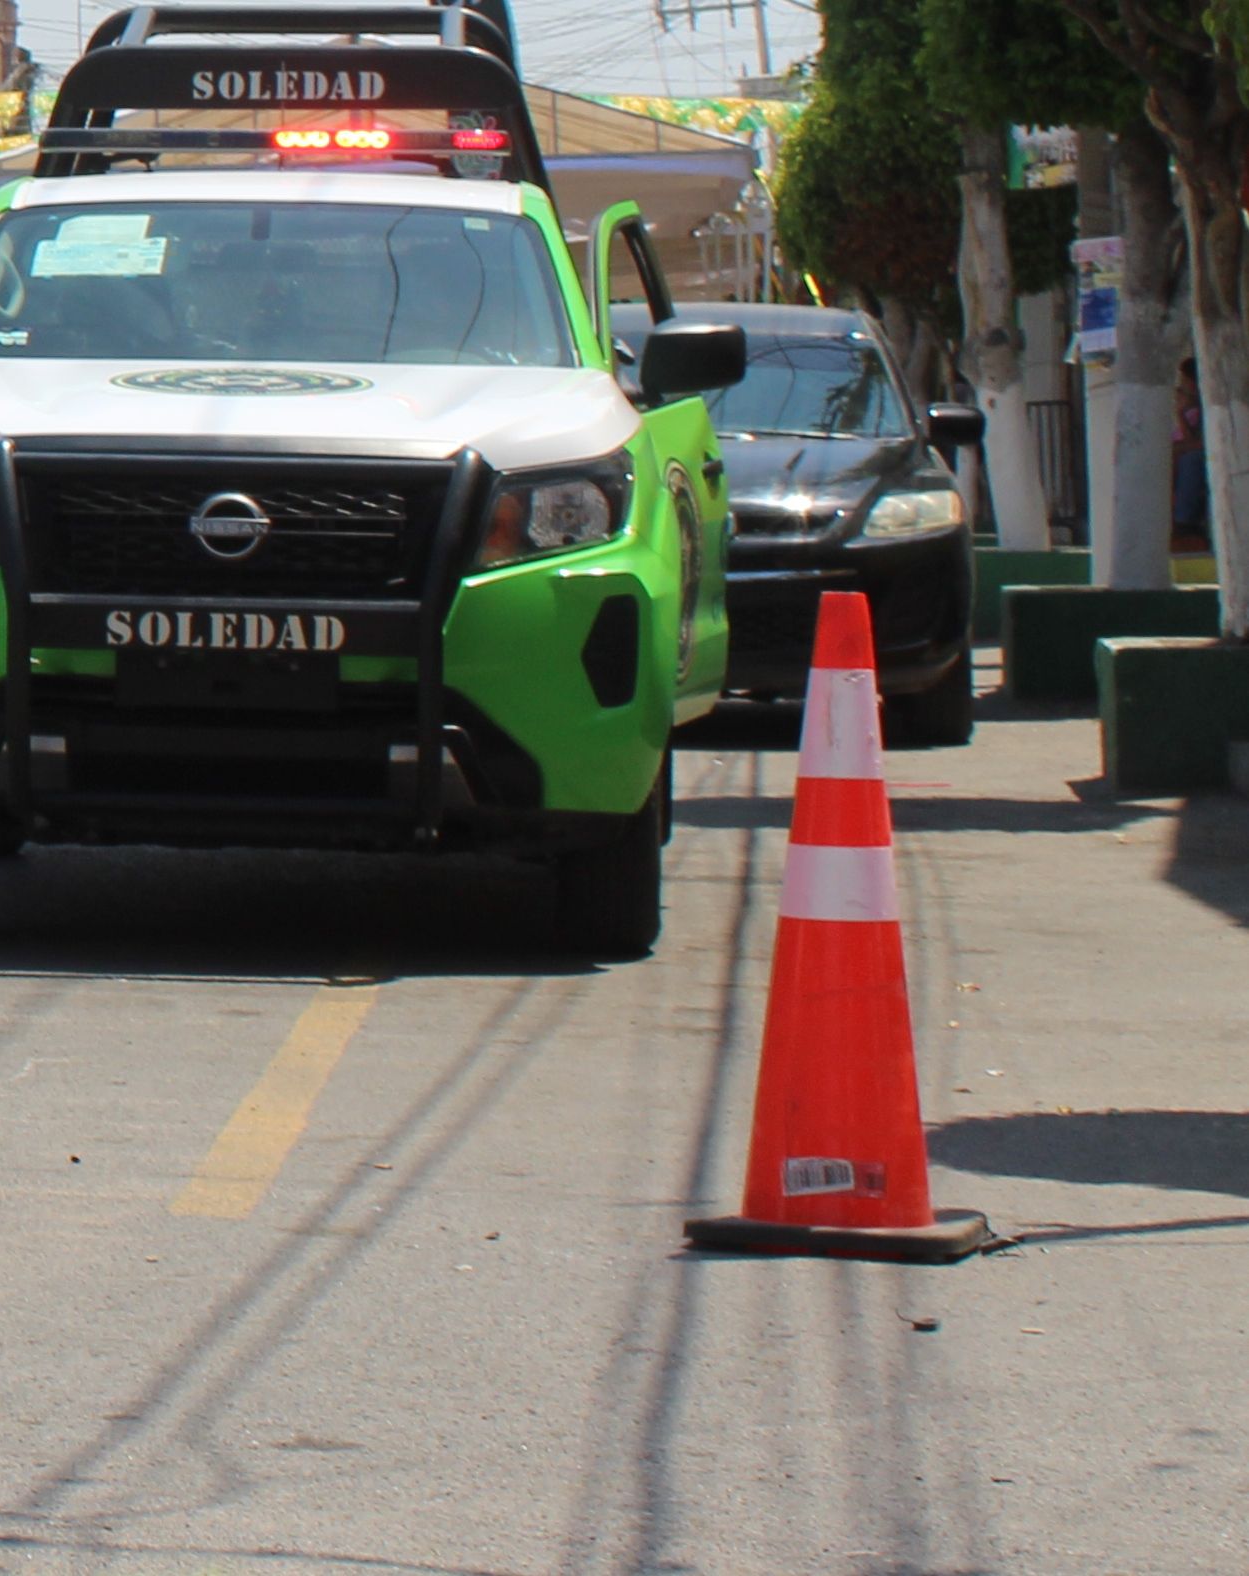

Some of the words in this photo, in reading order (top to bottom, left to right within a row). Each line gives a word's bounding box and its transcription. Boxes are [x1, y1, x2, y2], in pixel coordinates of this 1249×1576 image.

[191, 70, 386, 101] SOLEDAD
[192, 522, 268, 534] NISSAN
[106, 610, 346, 650] SOLEDAD
